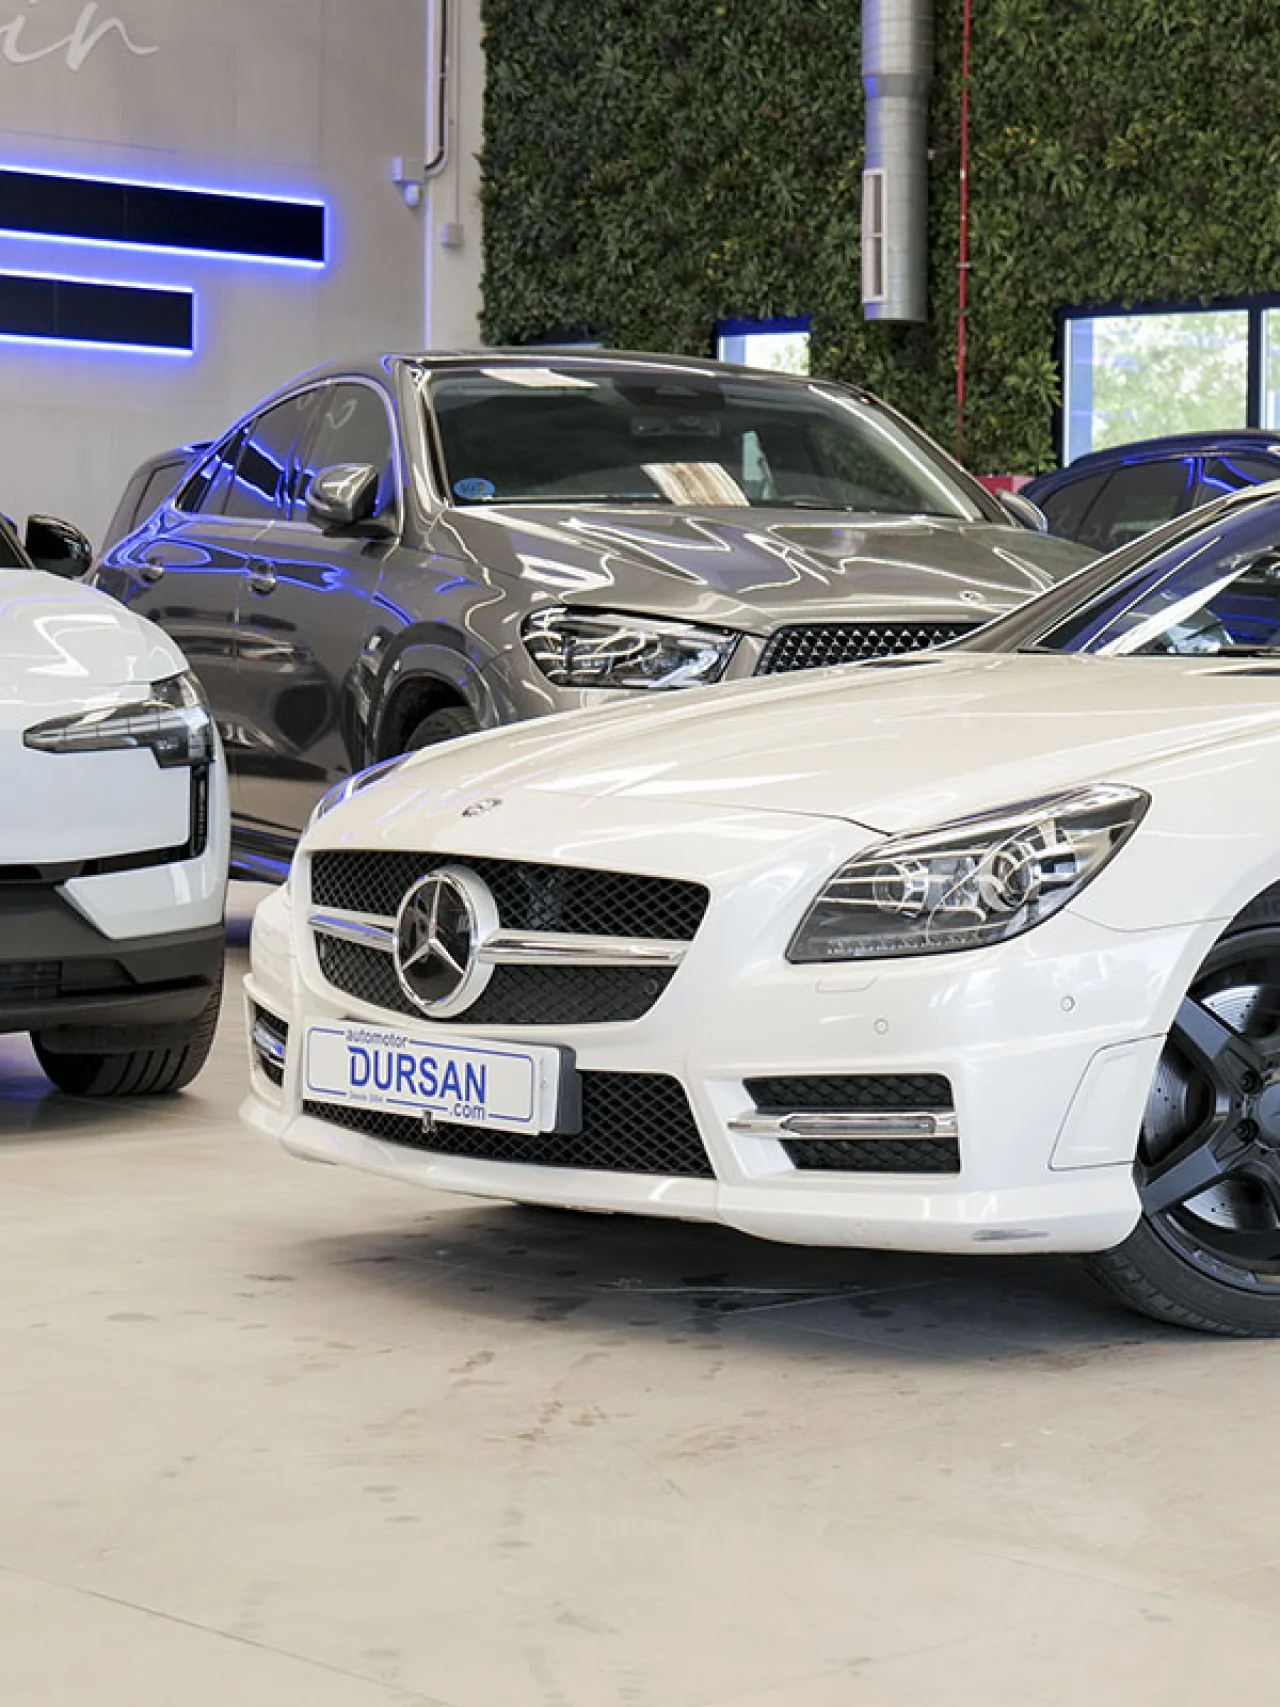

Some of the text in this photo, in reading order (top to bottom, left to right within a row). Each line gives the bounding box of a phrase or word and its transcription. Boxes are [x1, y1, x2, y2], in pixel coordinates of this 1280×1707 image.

[345, 1029, 408, 1049] automotor
[347, 1045, 486, 1104] DURSAN
[449, 1101, 486, 1120] .com
